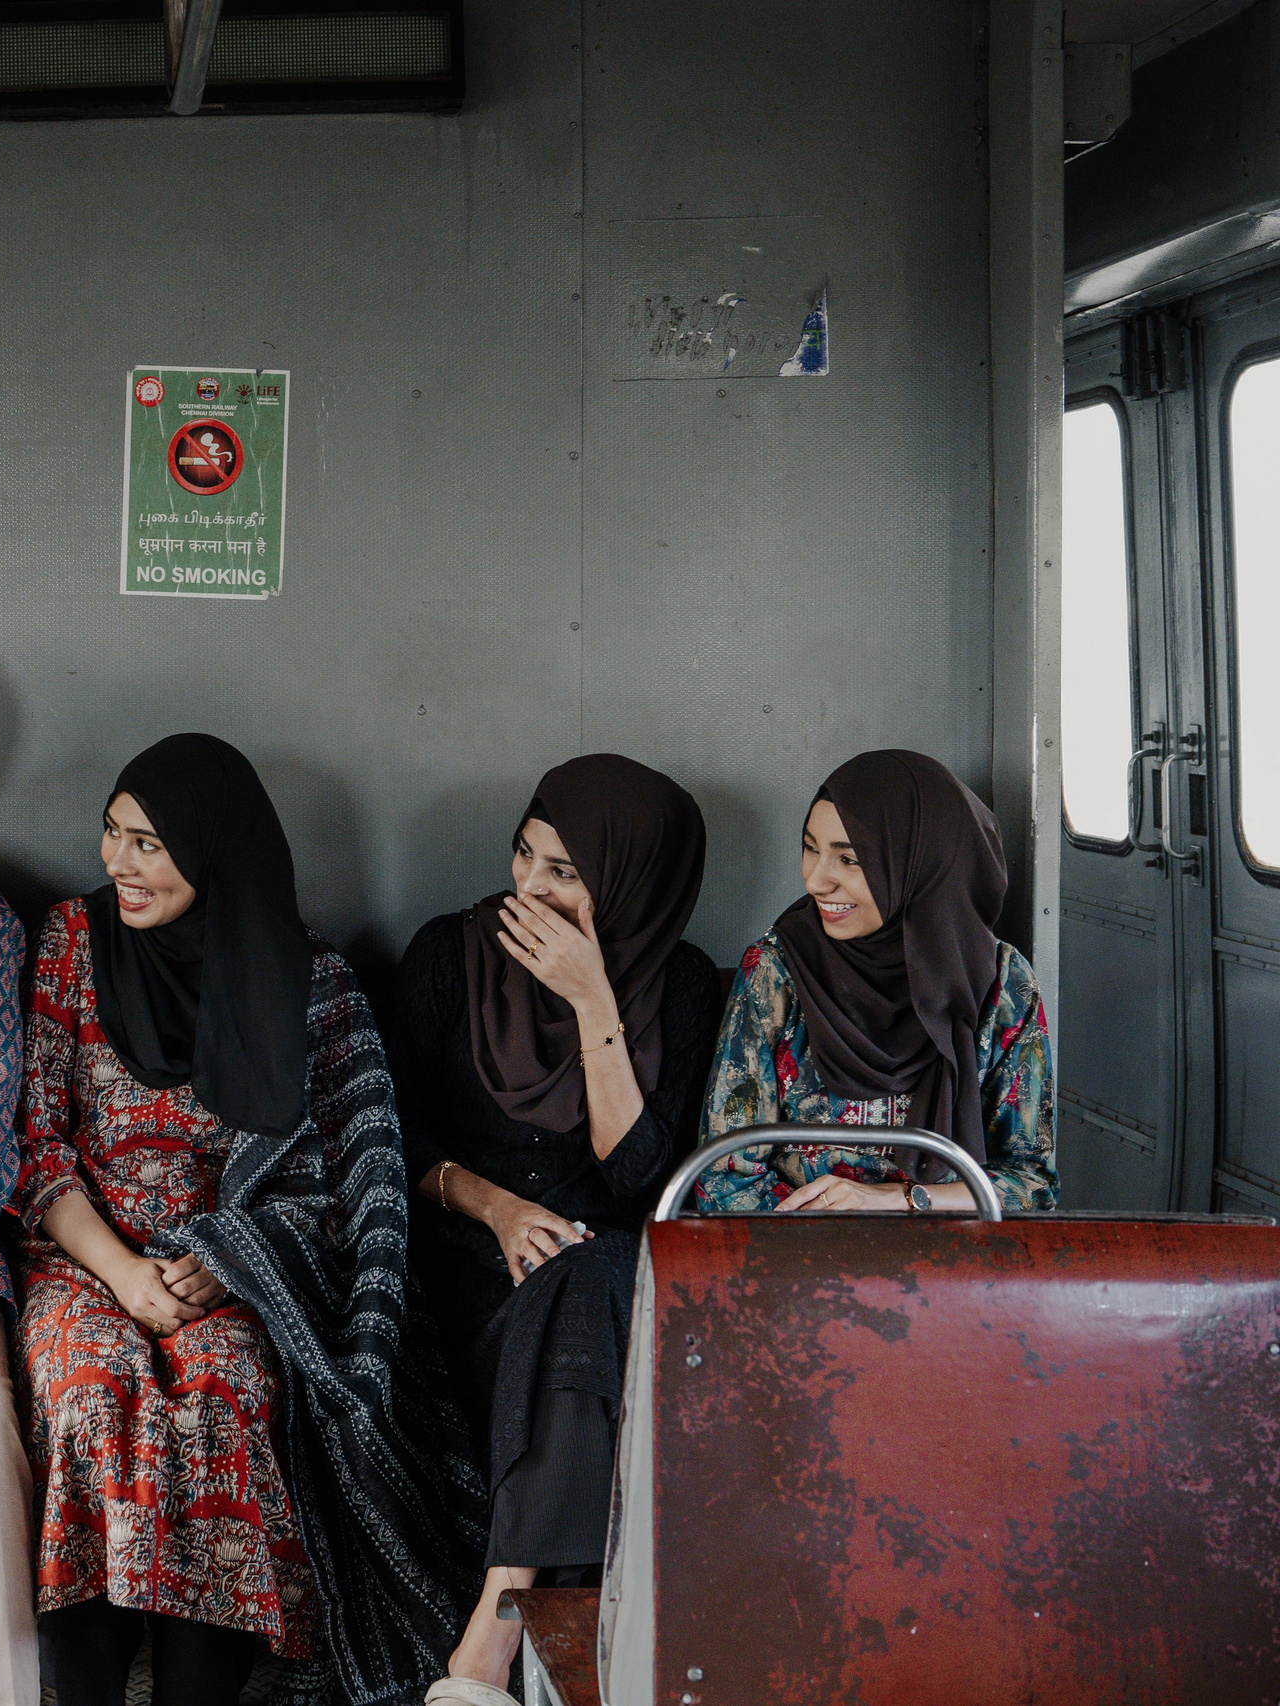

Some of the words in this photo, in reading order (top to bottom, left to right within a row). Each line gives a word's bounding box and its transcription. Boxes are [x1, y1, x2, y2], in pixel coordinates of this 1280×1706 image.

[257, 385, 280, 397] LiFE
[139, 513, 179, 527] புகை
[185, 509, 268, 530] பிடிக்காதீர்
[139, 538, 184, 556] धूम्रपान
[188, 540, 222, 553] करना
[226, 541, 252, 554] मना
[256, 536, 267, 557] है
[136, 566, 166, 582] NO
[171, 567, 267, 586] SMOKING
